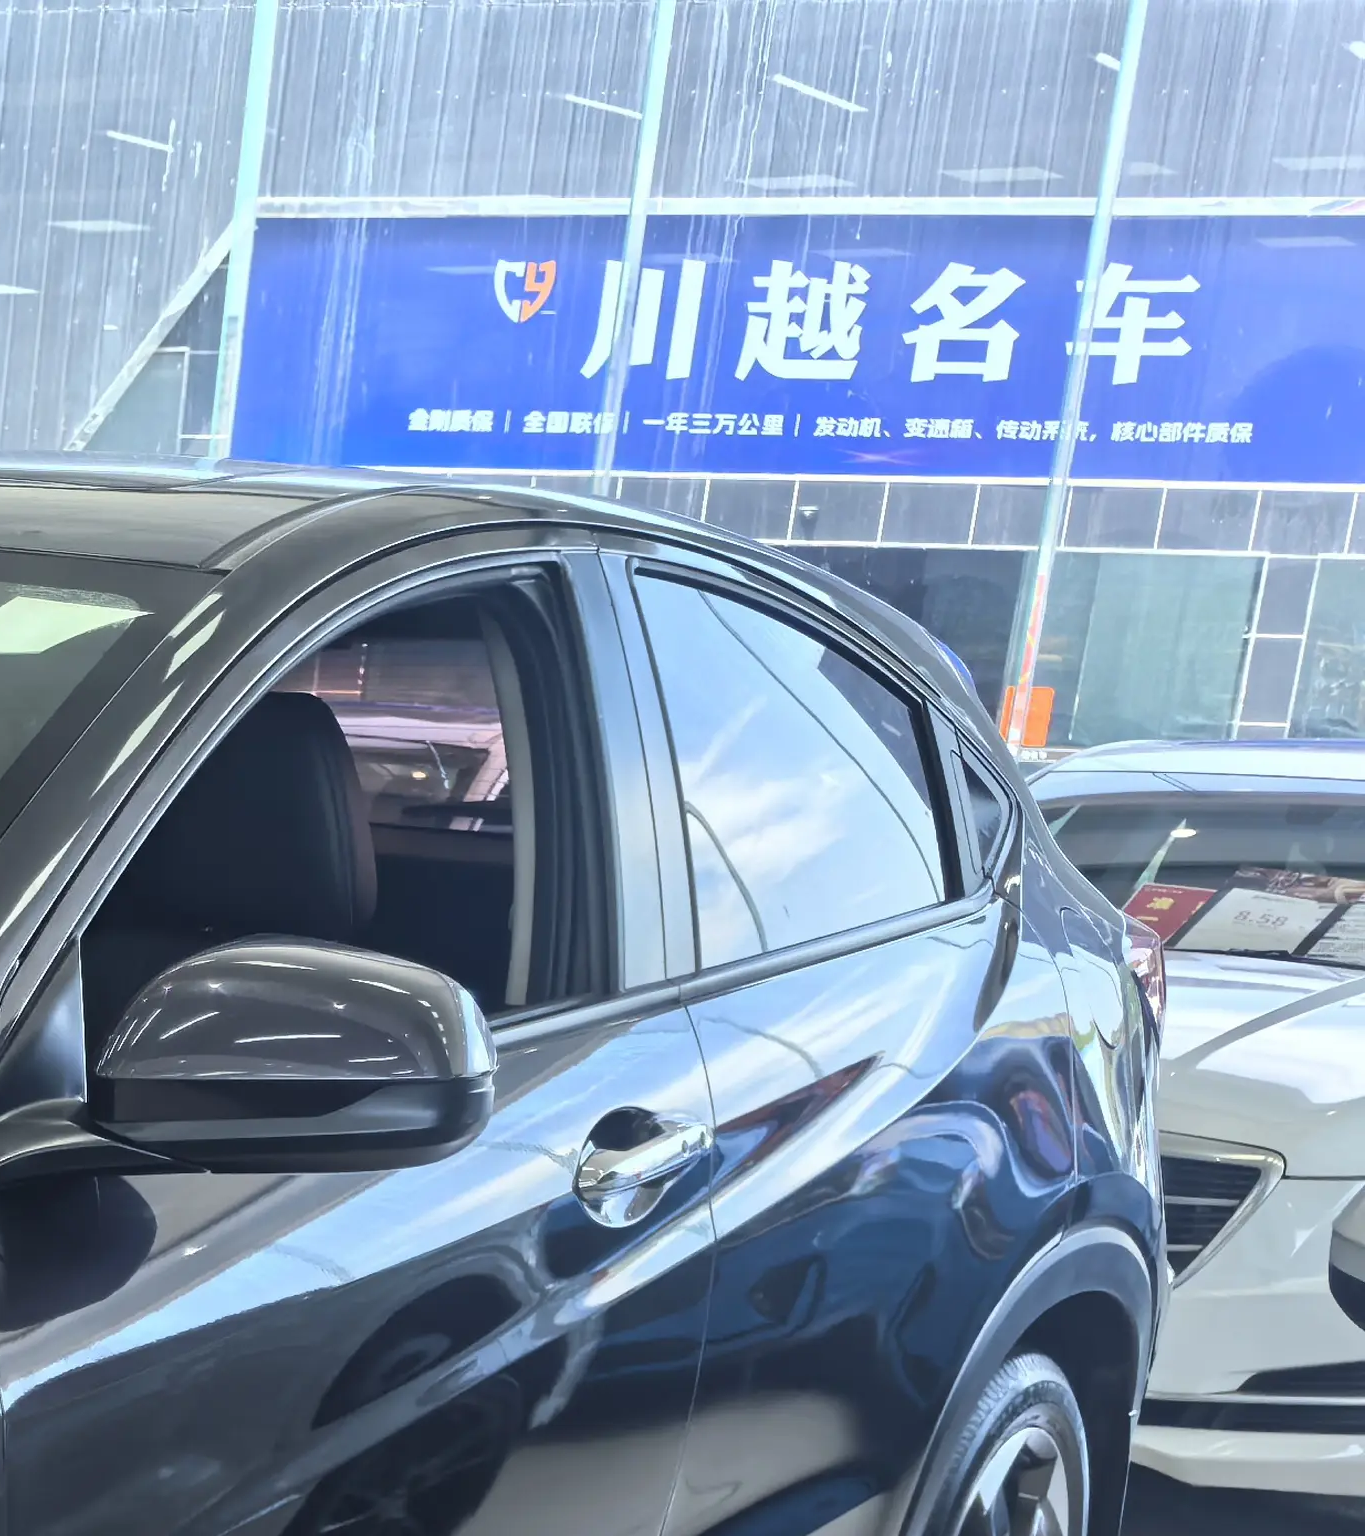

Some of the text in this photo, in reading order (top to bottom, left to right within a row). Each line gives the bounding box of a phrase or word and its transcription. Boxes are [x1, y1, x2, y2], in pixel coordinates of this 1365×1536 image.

[579, 259, 1202, 385] 川越名车
[642, 412, 785, 436] 一年三万公里
